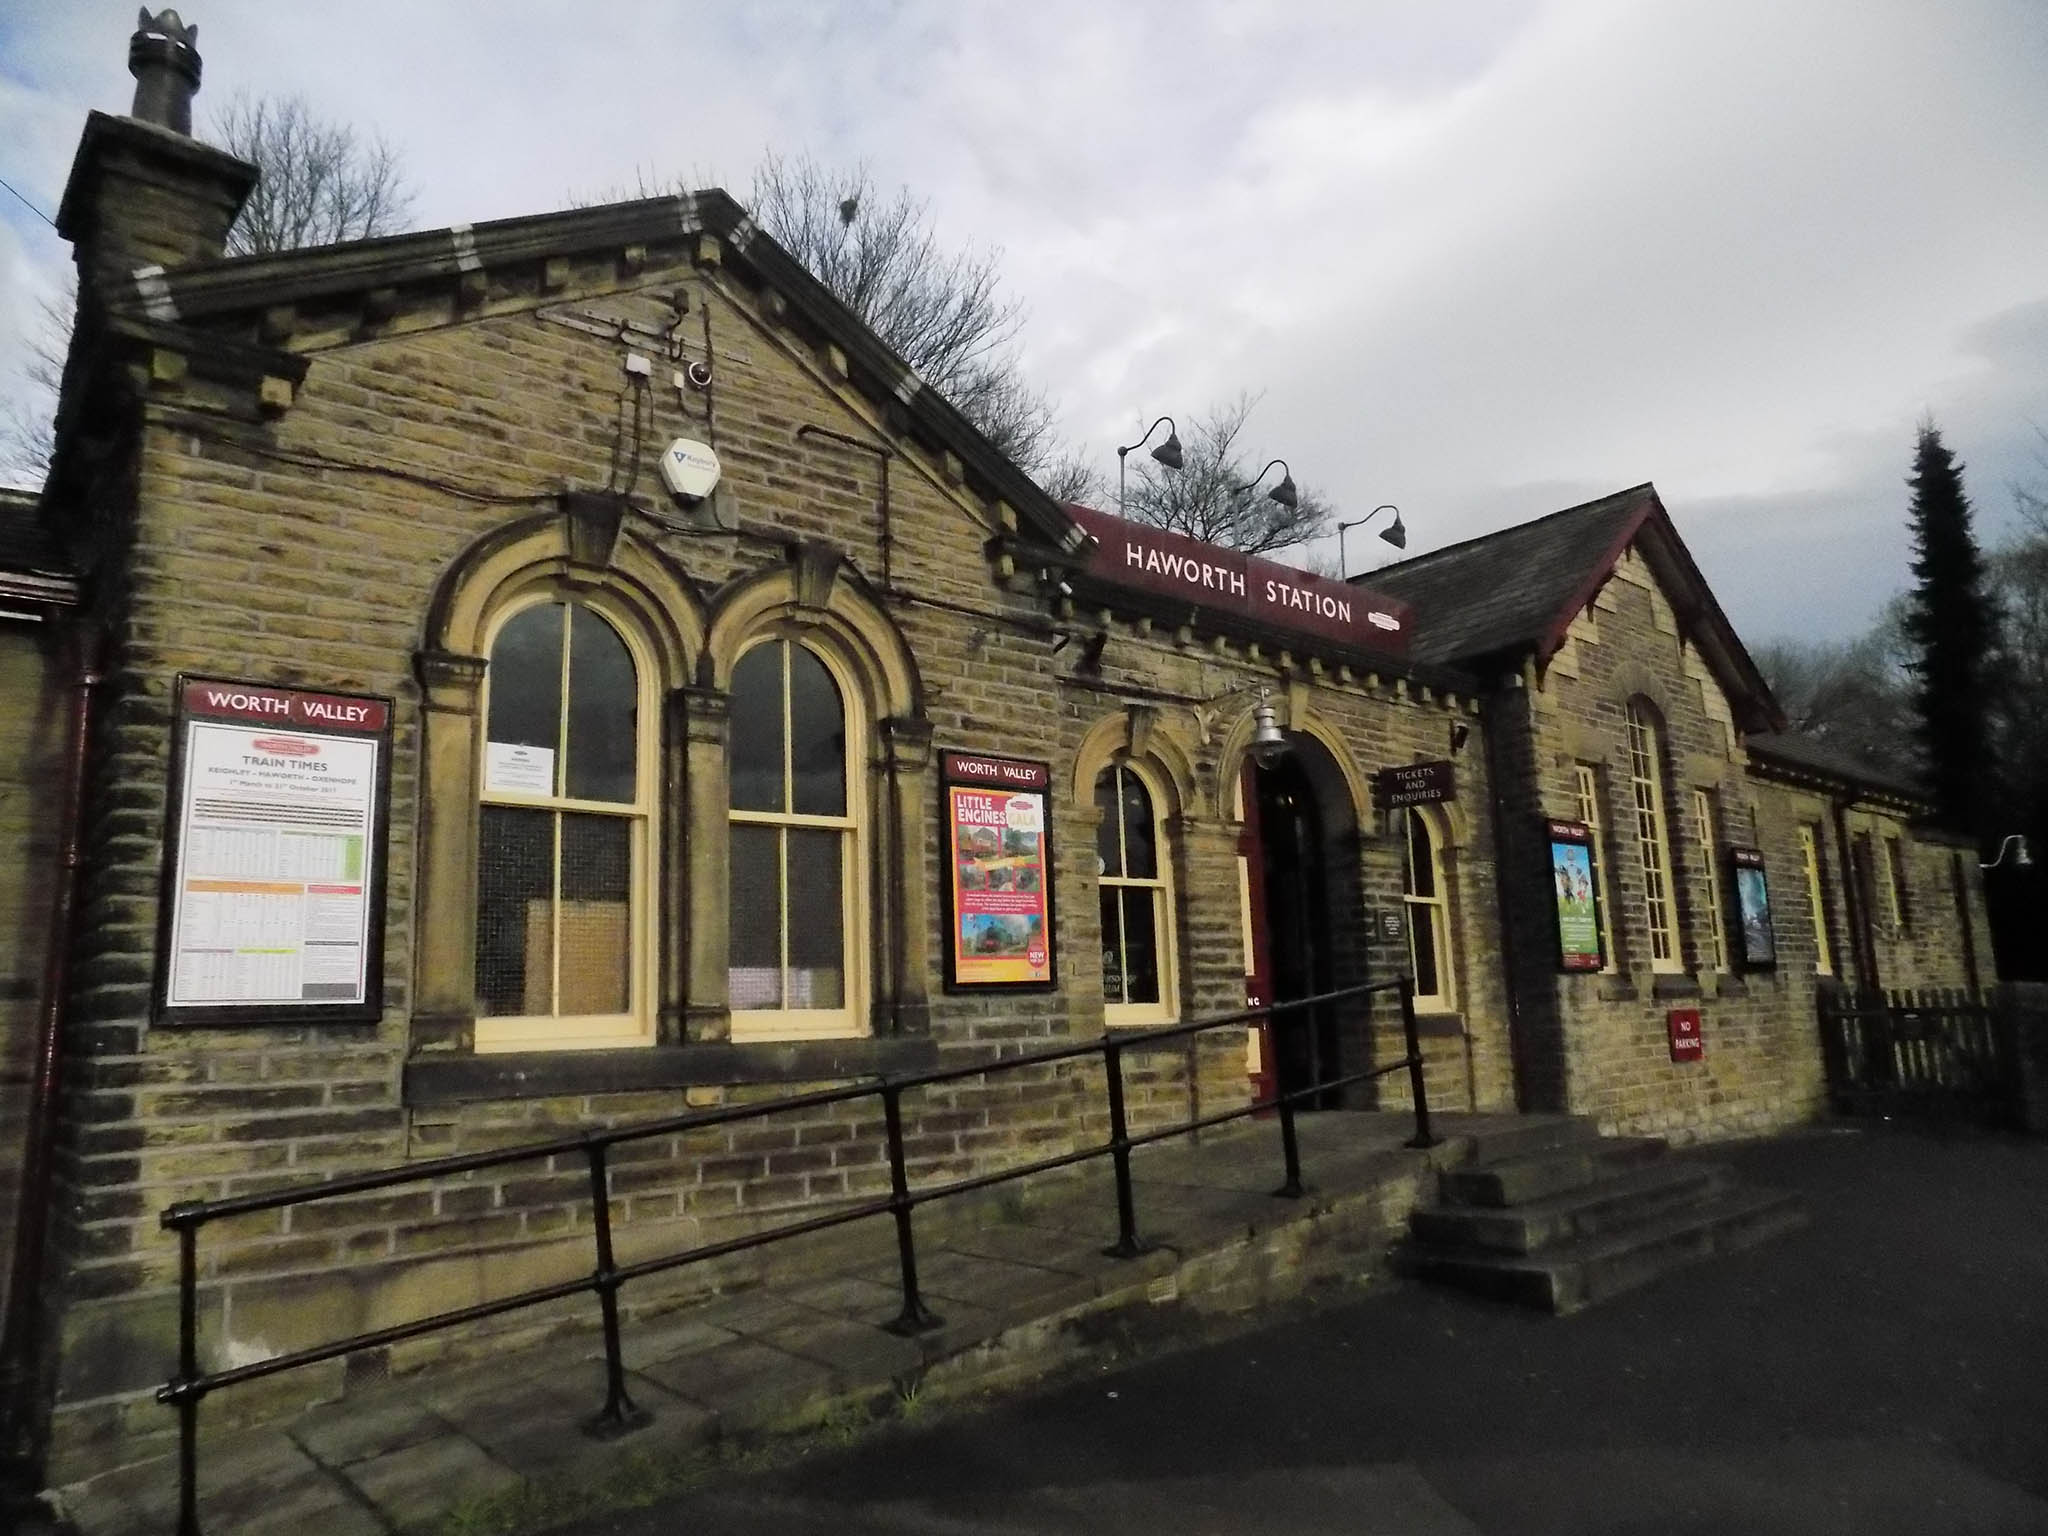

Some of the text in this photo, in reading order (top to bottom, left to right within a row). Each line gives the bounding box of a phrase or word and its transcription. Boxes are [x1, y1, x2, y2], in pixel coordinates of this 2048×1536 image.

[1126, 542, 1245, 597] HAWORTH
[1266, 580, 1351, 623] STATION
[207, 691, 369, 722] WORTH VALLEY
[242, 755, 328, 772] TRAIN TIMES
[957, 761, 1037, 781] WORTH VALLEY
[258, 770, 304, 781] HAWORTH
[311, 774, 357, 786] OXENHOPE
[1395, 767, 1435, 781] TICKETS
[1405, 780, 1426, 791] AND
[957, 795, 993, 810] LITTLE
[1391, 788, 1441, 804] ENQUIRIES
[957, 808, 1007, 826] ENGINES
[1029, 951, 1045, 960] NEW
[1680, 1021, 1691, 1031] NO
[1675, 1037, 1700, 1049] PARKING
